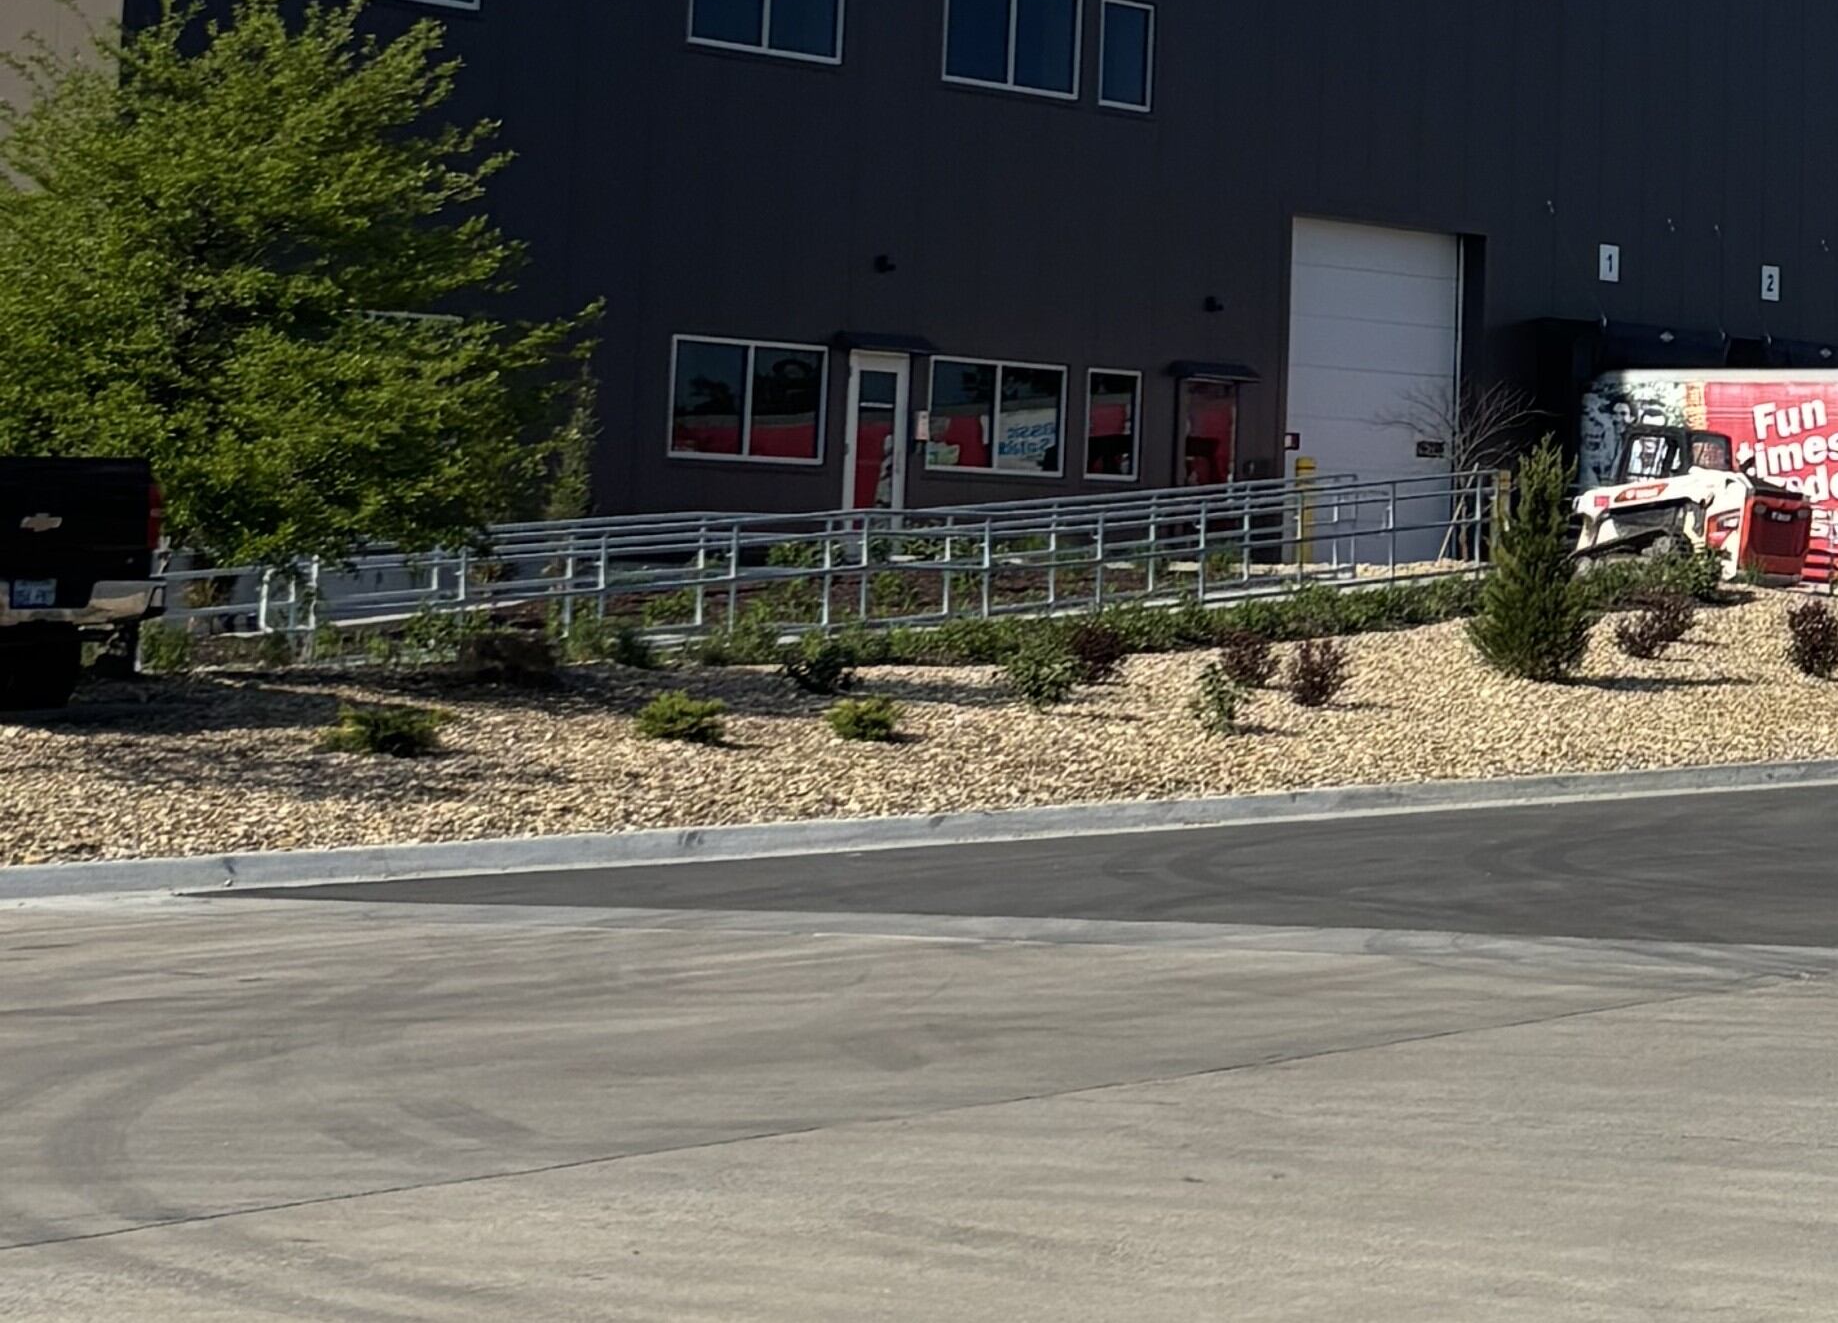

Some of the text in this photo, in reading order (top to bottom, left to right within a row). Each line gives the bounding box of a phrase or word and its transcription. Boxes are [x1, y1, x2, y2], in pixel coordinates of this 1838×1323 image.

[1606, 253, 1613, 273] 1
[1766, 274, 1775, 293] 2
[1752, 399, 1827, 440] Fun
